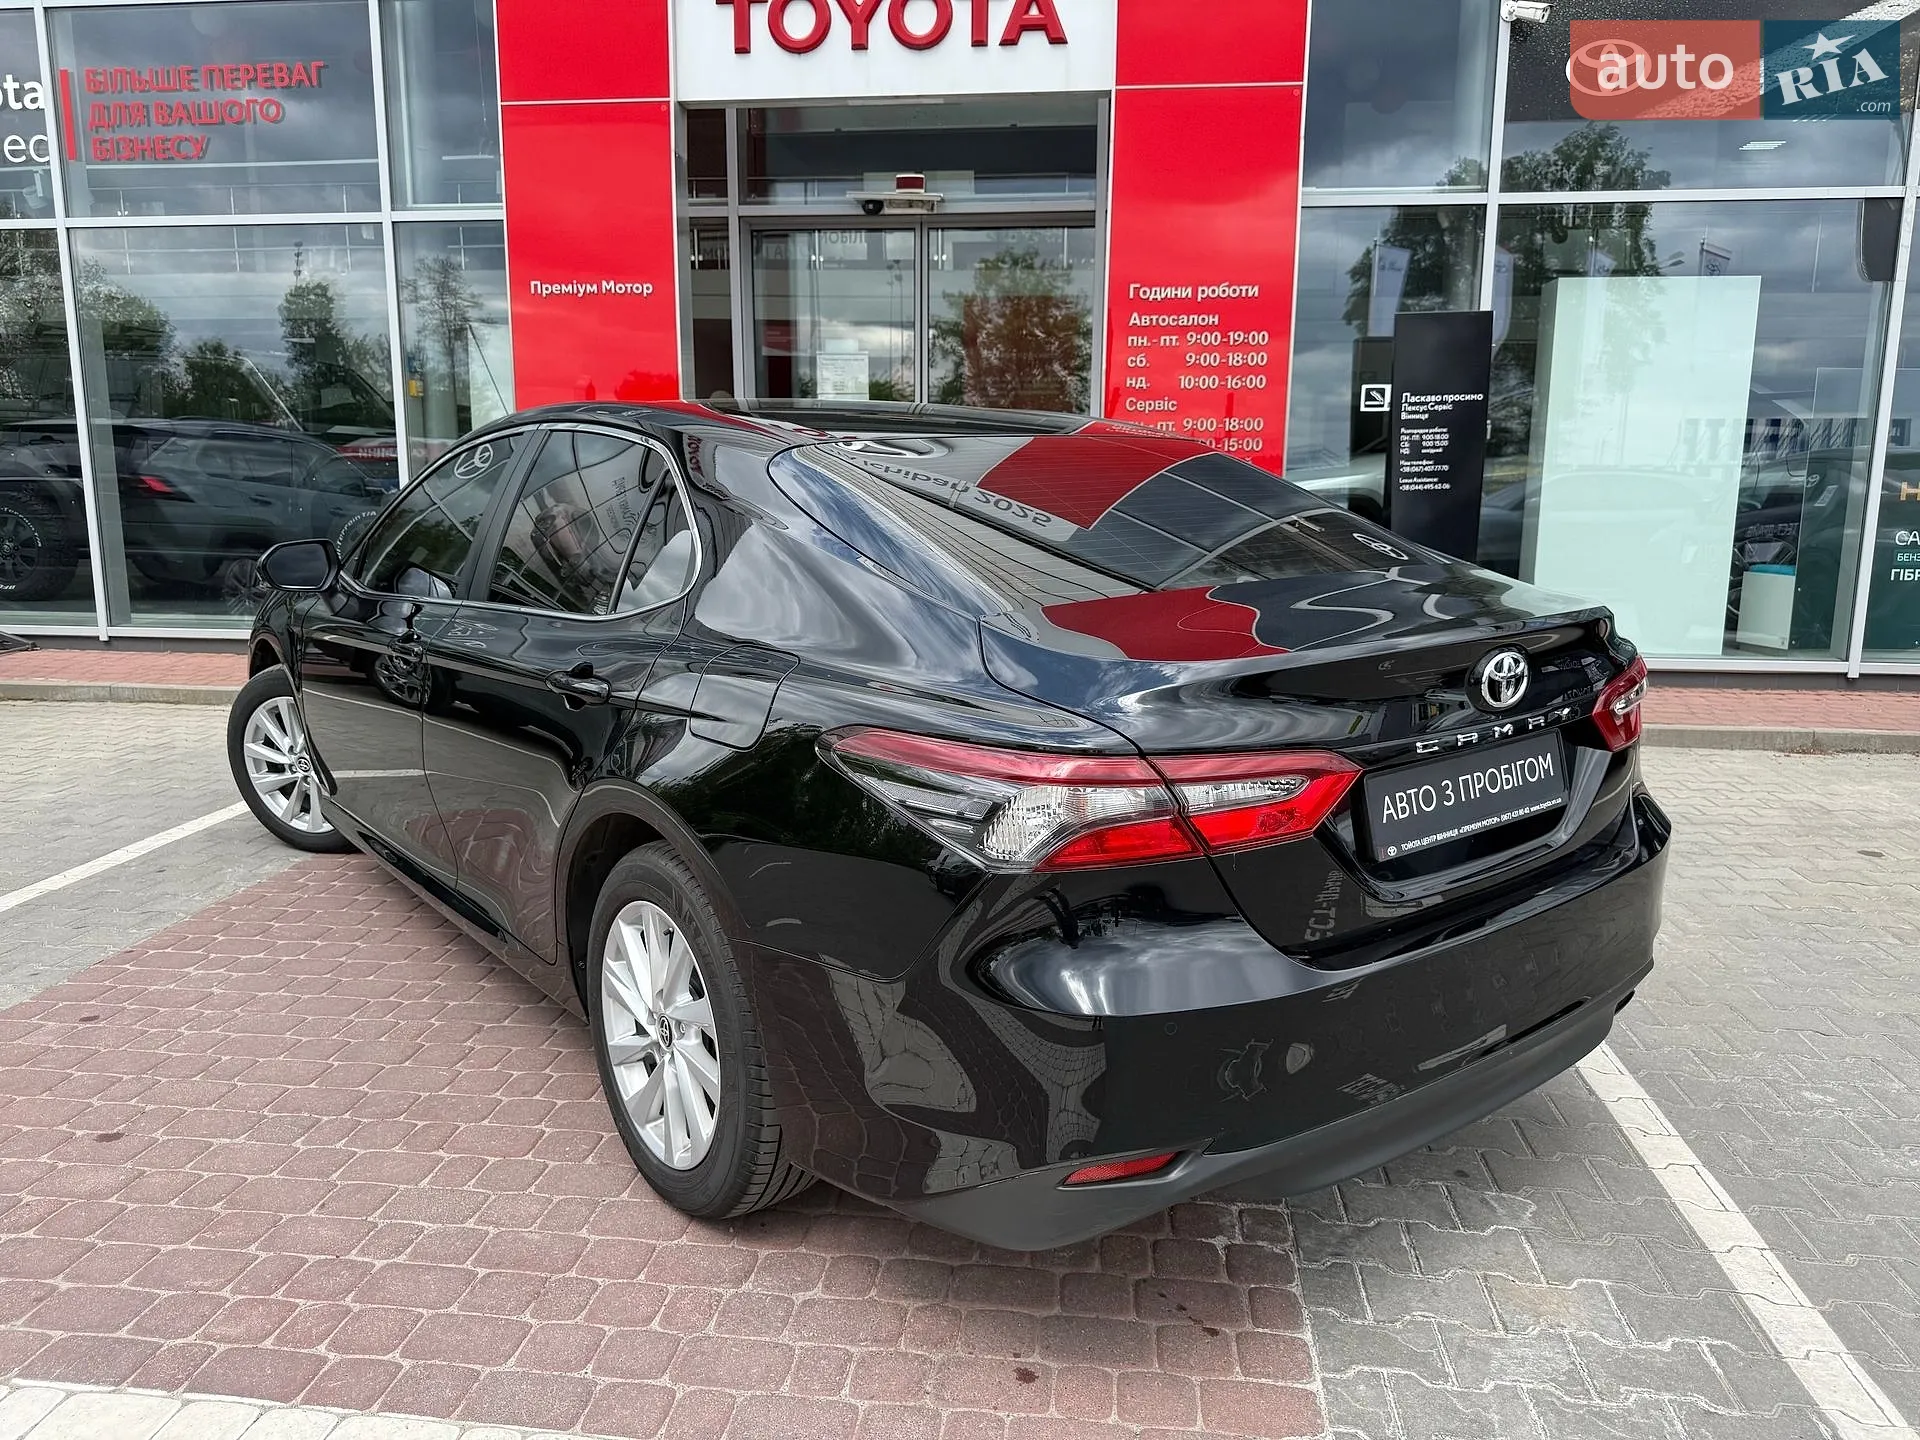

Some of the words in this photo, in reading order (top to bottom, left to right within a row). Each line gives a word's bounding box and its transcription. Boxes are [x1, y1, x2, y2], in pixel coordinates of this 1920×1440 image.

[716, 0, 1067, 53] TOYOTA
[84, 64, 194, 93] БІЛЬШЕ
[202, 61, 325, 88] ПЕРЕВАГ
[0, 74, 45, 110] ta
[89, 102, 145, 131] ДЛЯ
[154, 98, 284, 124] ВАШОГО
[92, 135, 208, 161] БІЗНЕСУ
[530, 279, 598, 298] Преміум
[602, 280, 653, 298] Мотор
[1129, 283, 1192, 301] Години
[1197, 282, 1259, 302] роботи
[1128, 312, 1219, 327] Автосалон
[1127, 354, 1150, 368] сб.
[1185, 352, 1268, 367] 9:00-18:00
[1126, 376, 1150, 389] нд.
[1179, 375, 1267, 389] 10:00-16:00
[1125, 397, 1178, 413] Сервіс
[1443, 394, 1484, 403] просимо
[1183, 417, 1264, 432] 9:00-18:00
[1416, 706, 1571, 754] CAMRY
[1382, 784, 1436, 824] АВТО
[1459, 752, 1554, 802] ПРОБІГОМ
